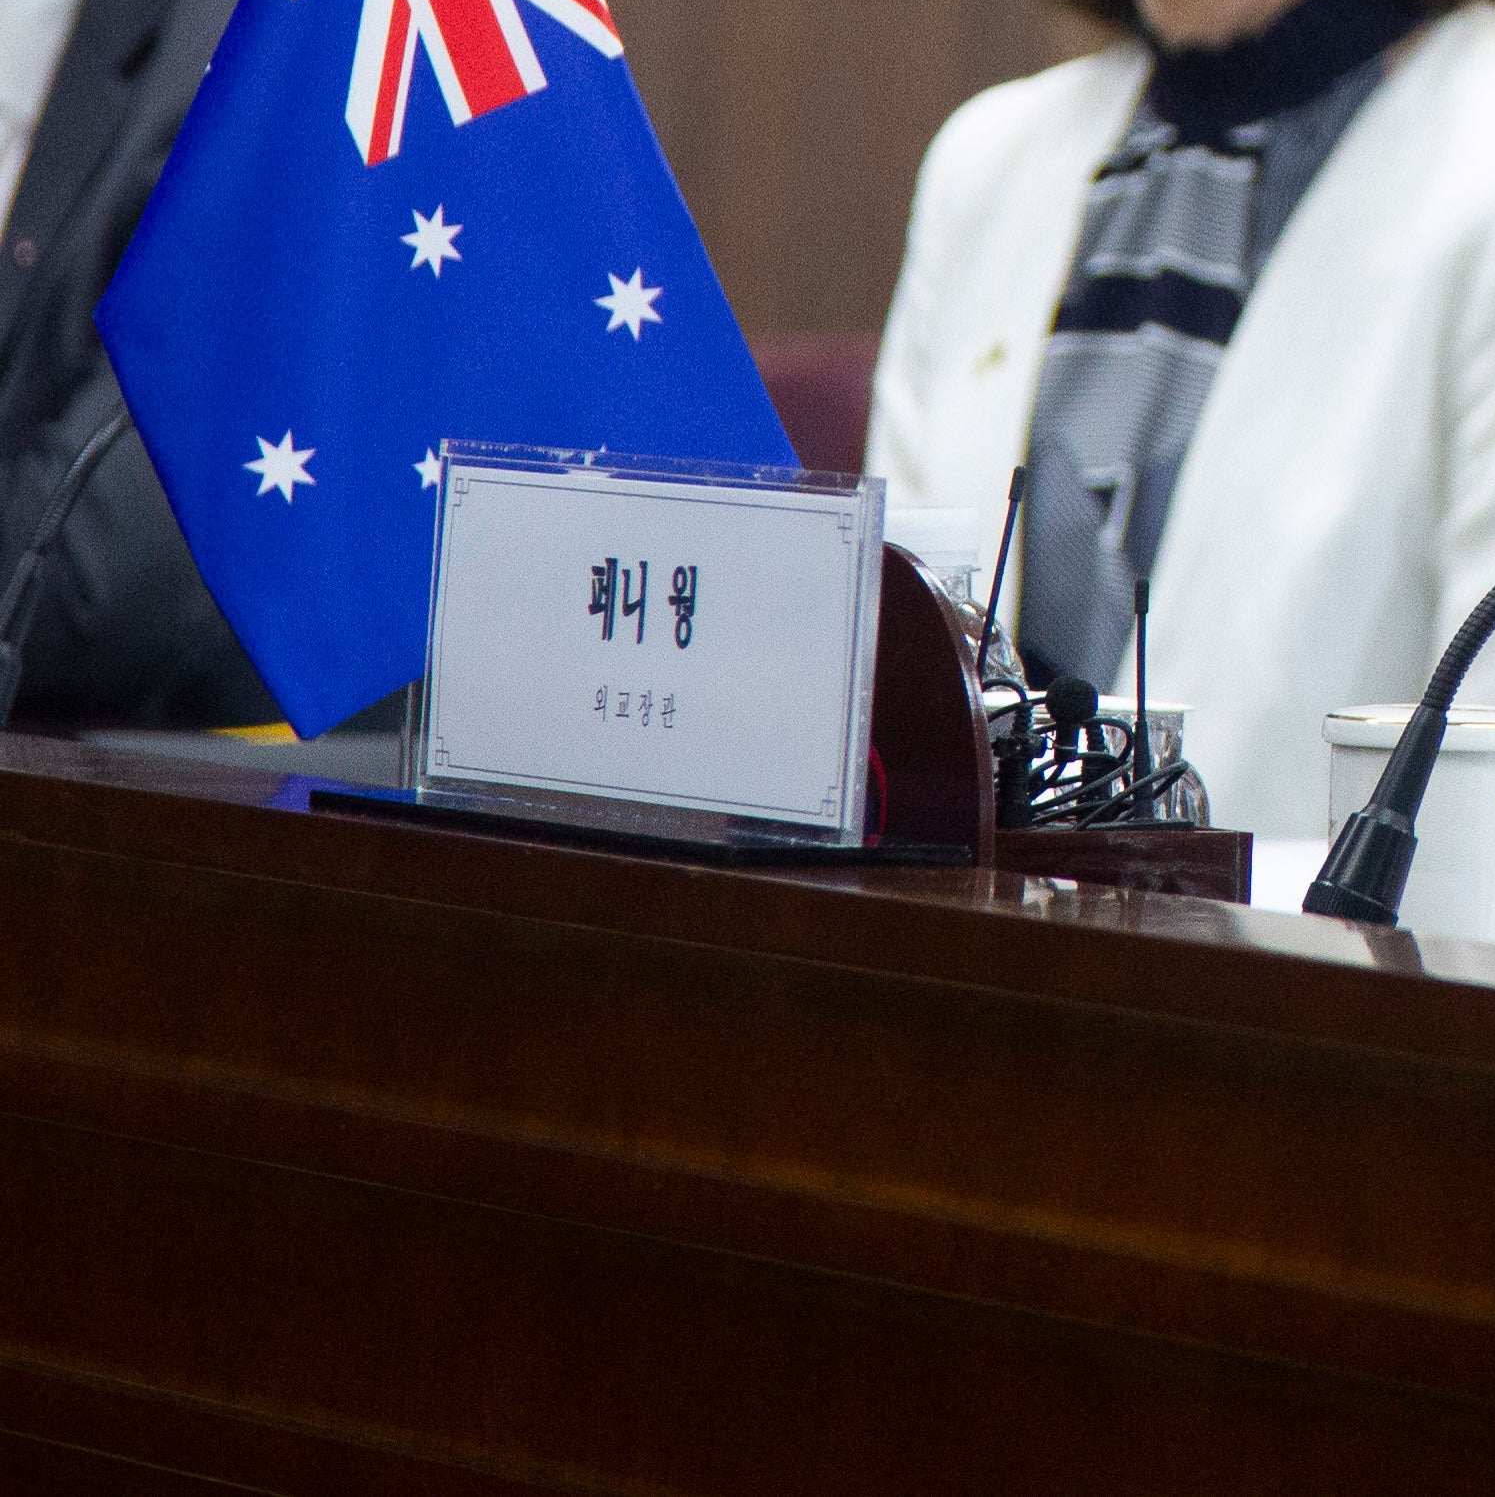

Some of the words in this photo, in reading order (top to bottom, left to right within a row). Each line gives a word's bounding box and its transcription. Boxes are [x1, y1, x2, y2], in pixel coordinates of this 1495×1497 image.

[588, 557, 648, 644] 페니
[668, 565, 697, 650] 웡
[593, 685, 676, 729] 외교장관
